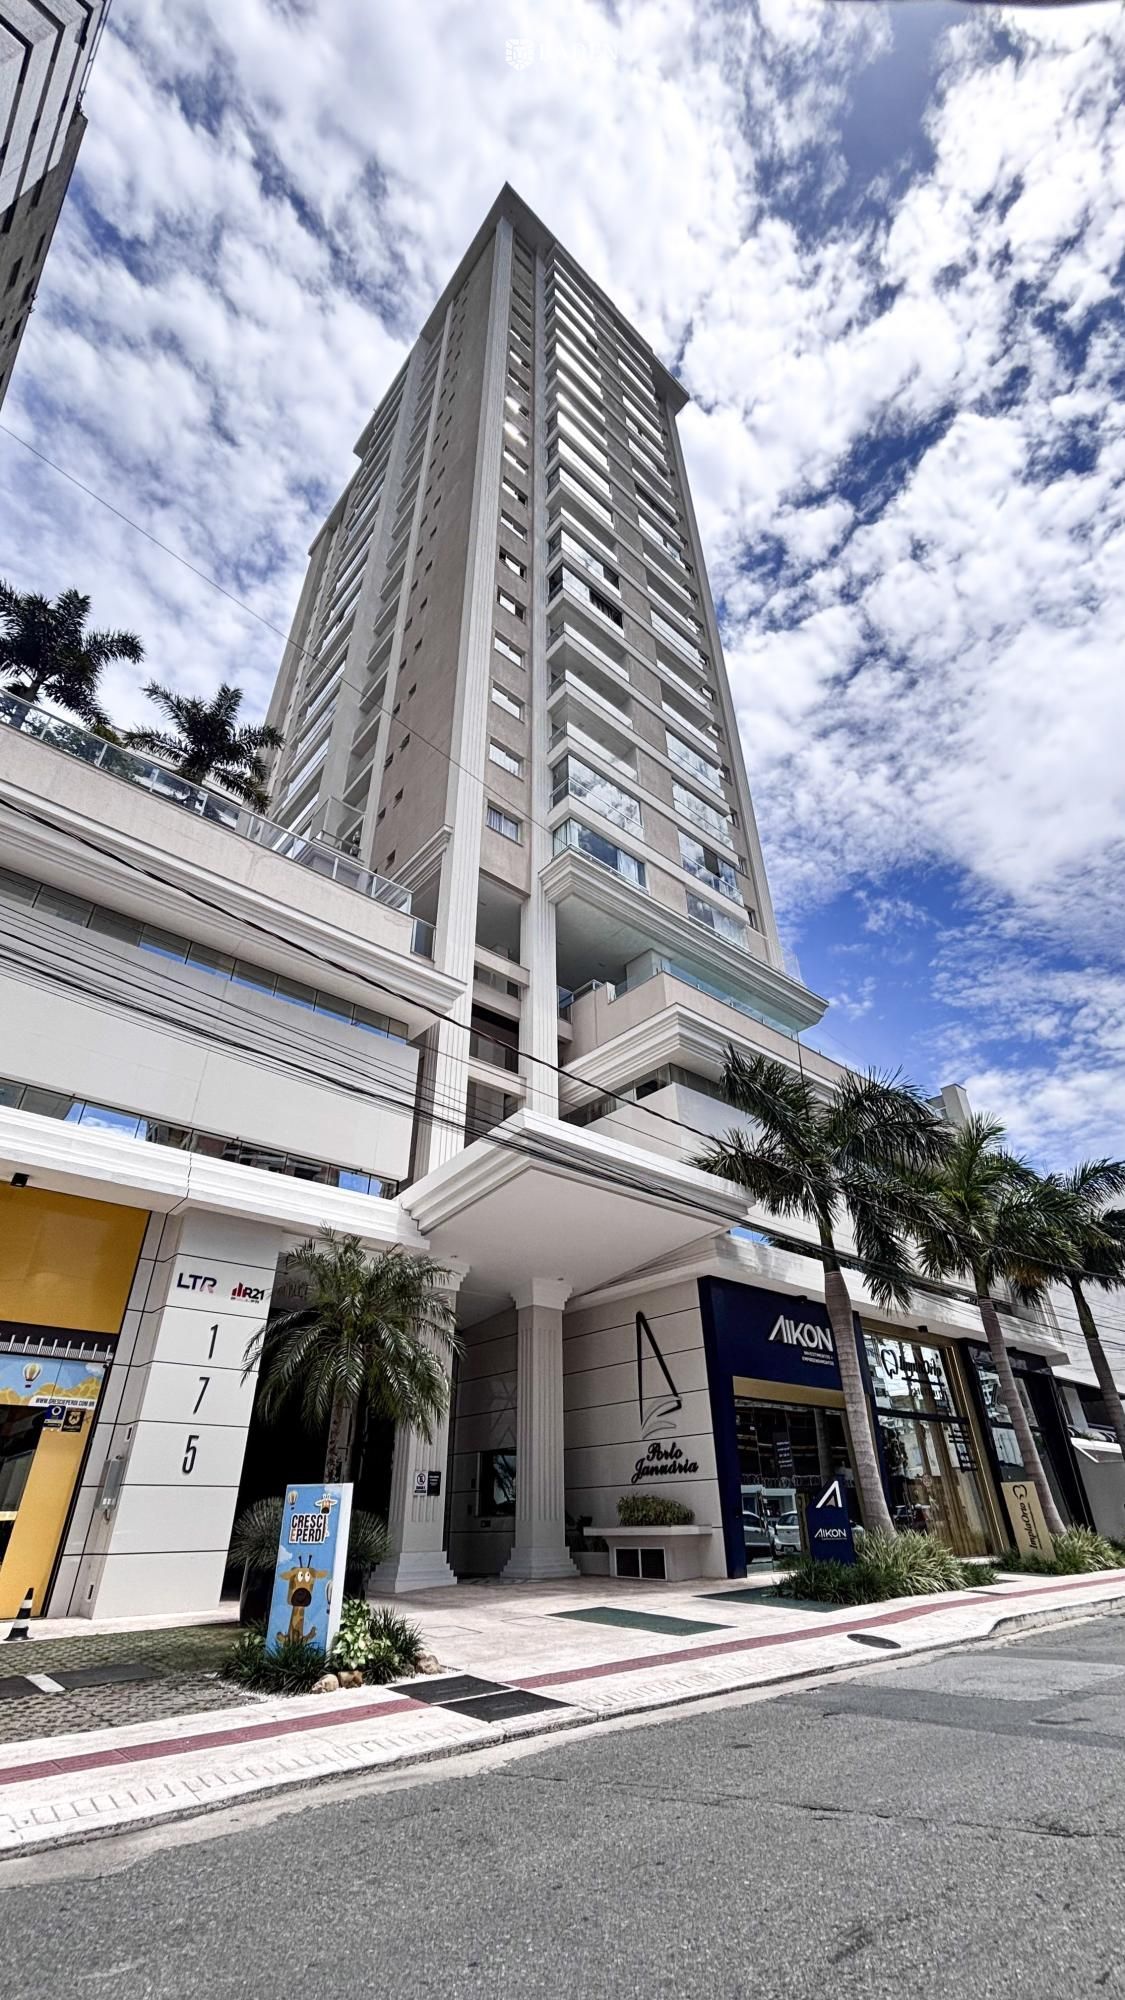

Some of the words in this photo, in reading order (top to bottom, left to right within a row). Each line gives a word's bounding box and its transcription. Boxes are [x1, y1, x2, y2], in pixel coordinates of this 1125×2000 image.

[176, 1272, 217, 1294] LTR
[768, 1314, 834, 1352] AIKON
[646, 1441, 683, 1462] Porto
[291, 1514, 327, 1529] CRESCI
[814, 1527, 847, 1539] AIKON
